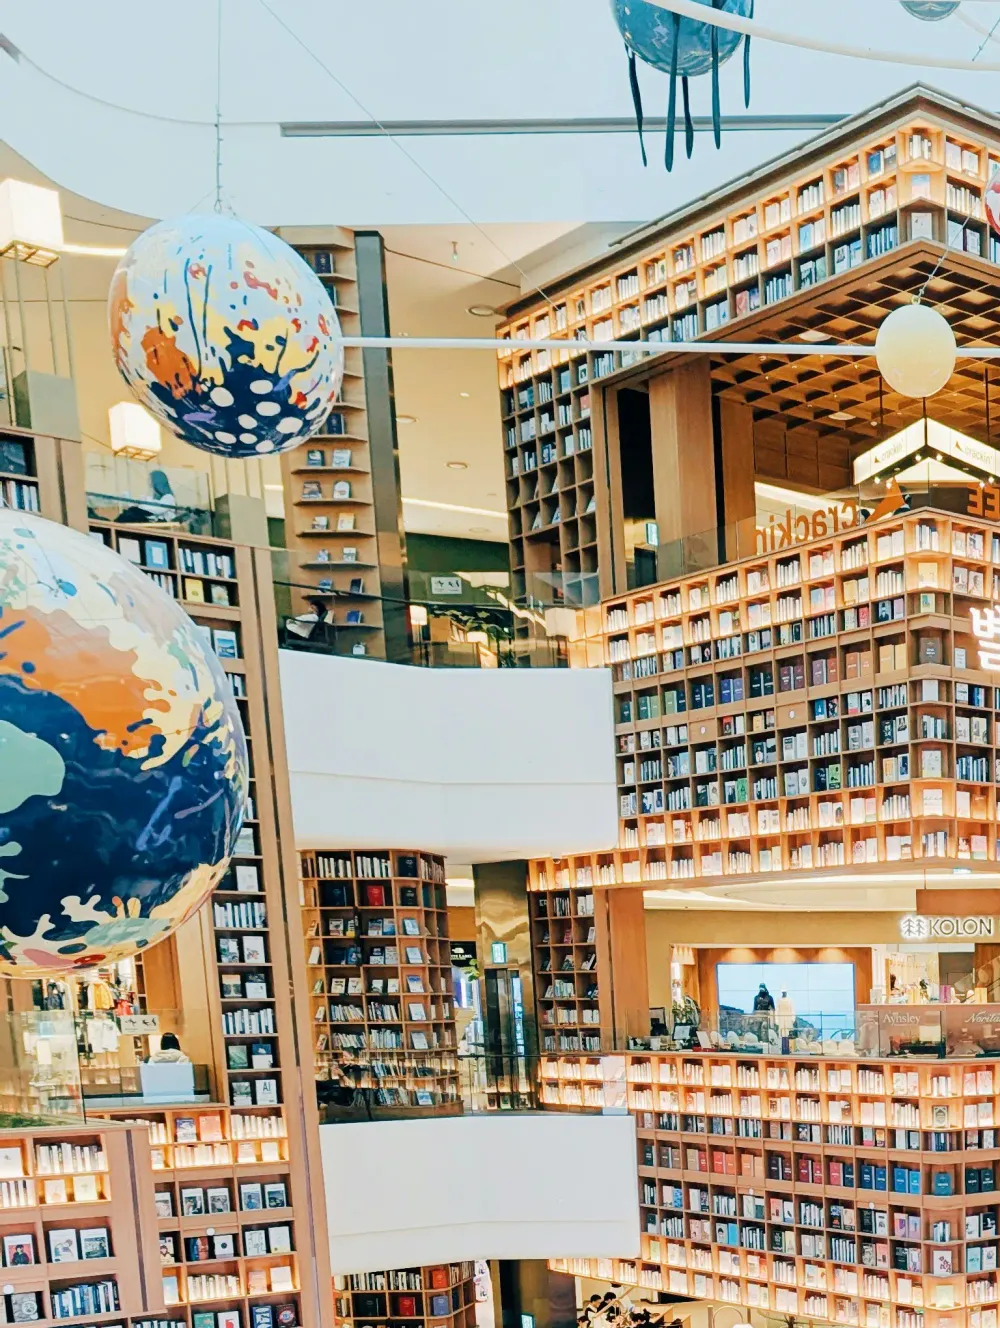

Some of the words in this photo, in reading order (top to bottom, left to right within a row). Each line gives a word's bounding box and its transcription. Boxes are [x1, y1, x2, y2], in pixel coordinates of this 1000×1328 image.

[965, 446, 993, 465] crackin'
[929, 918, 992, 935] KOLON
[883, 1012, 921, 1025] Aynsley
